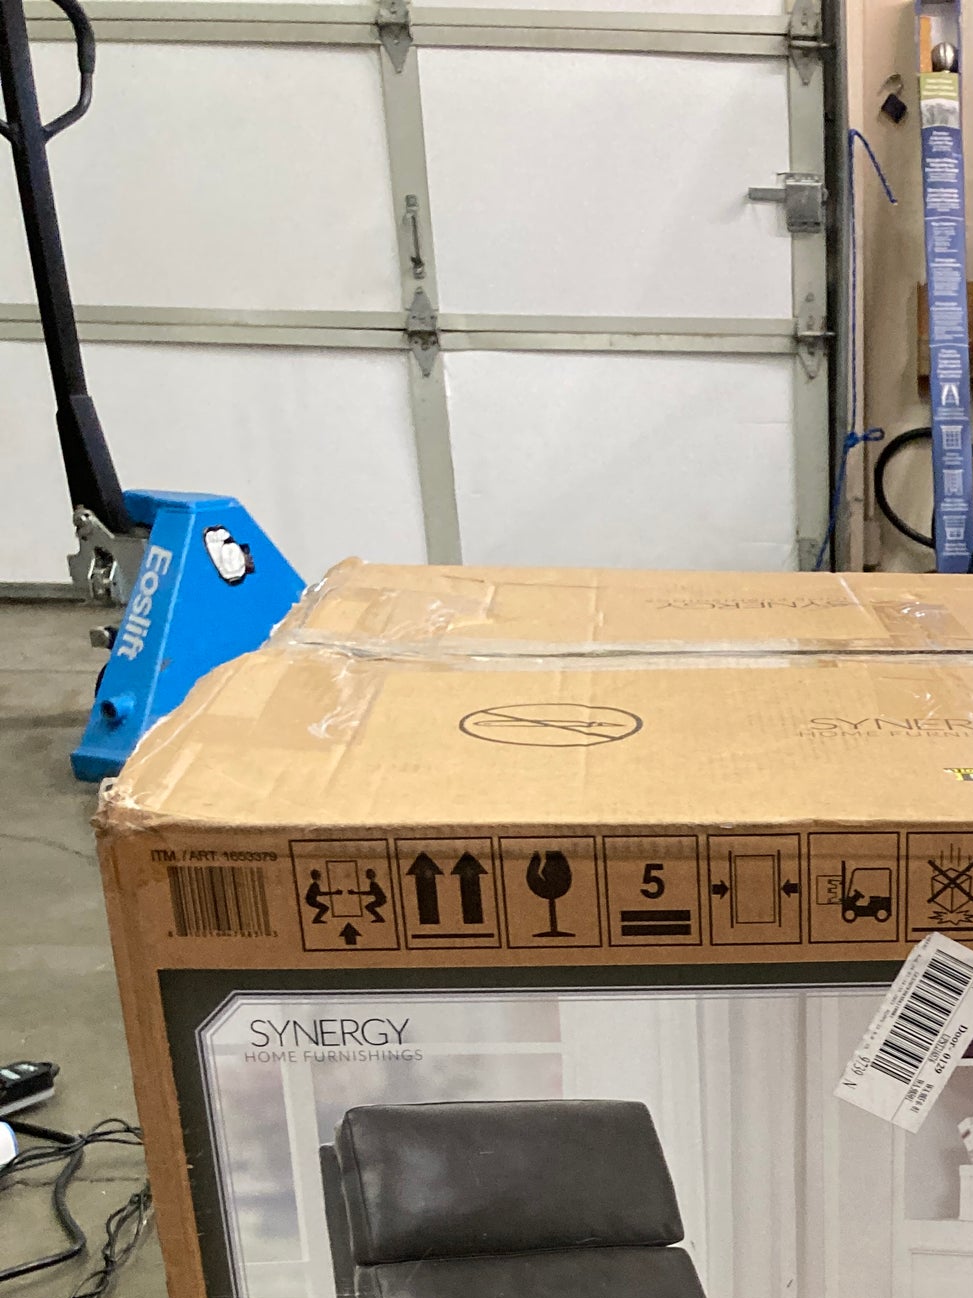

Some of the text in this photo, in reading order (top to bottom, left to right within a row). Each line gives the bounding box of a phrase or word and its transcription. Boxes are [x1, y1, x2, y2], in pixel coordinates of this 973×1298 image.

[117, 544, 173, 661] Eoslift
[640, 863, 666, 899] 5
[249, 1017, 410, 1048] SYNERGY
[245, 1049, 424, 1064] HOME FURNISHINGS
[842, 1054, 872, 1090] 9739 N
